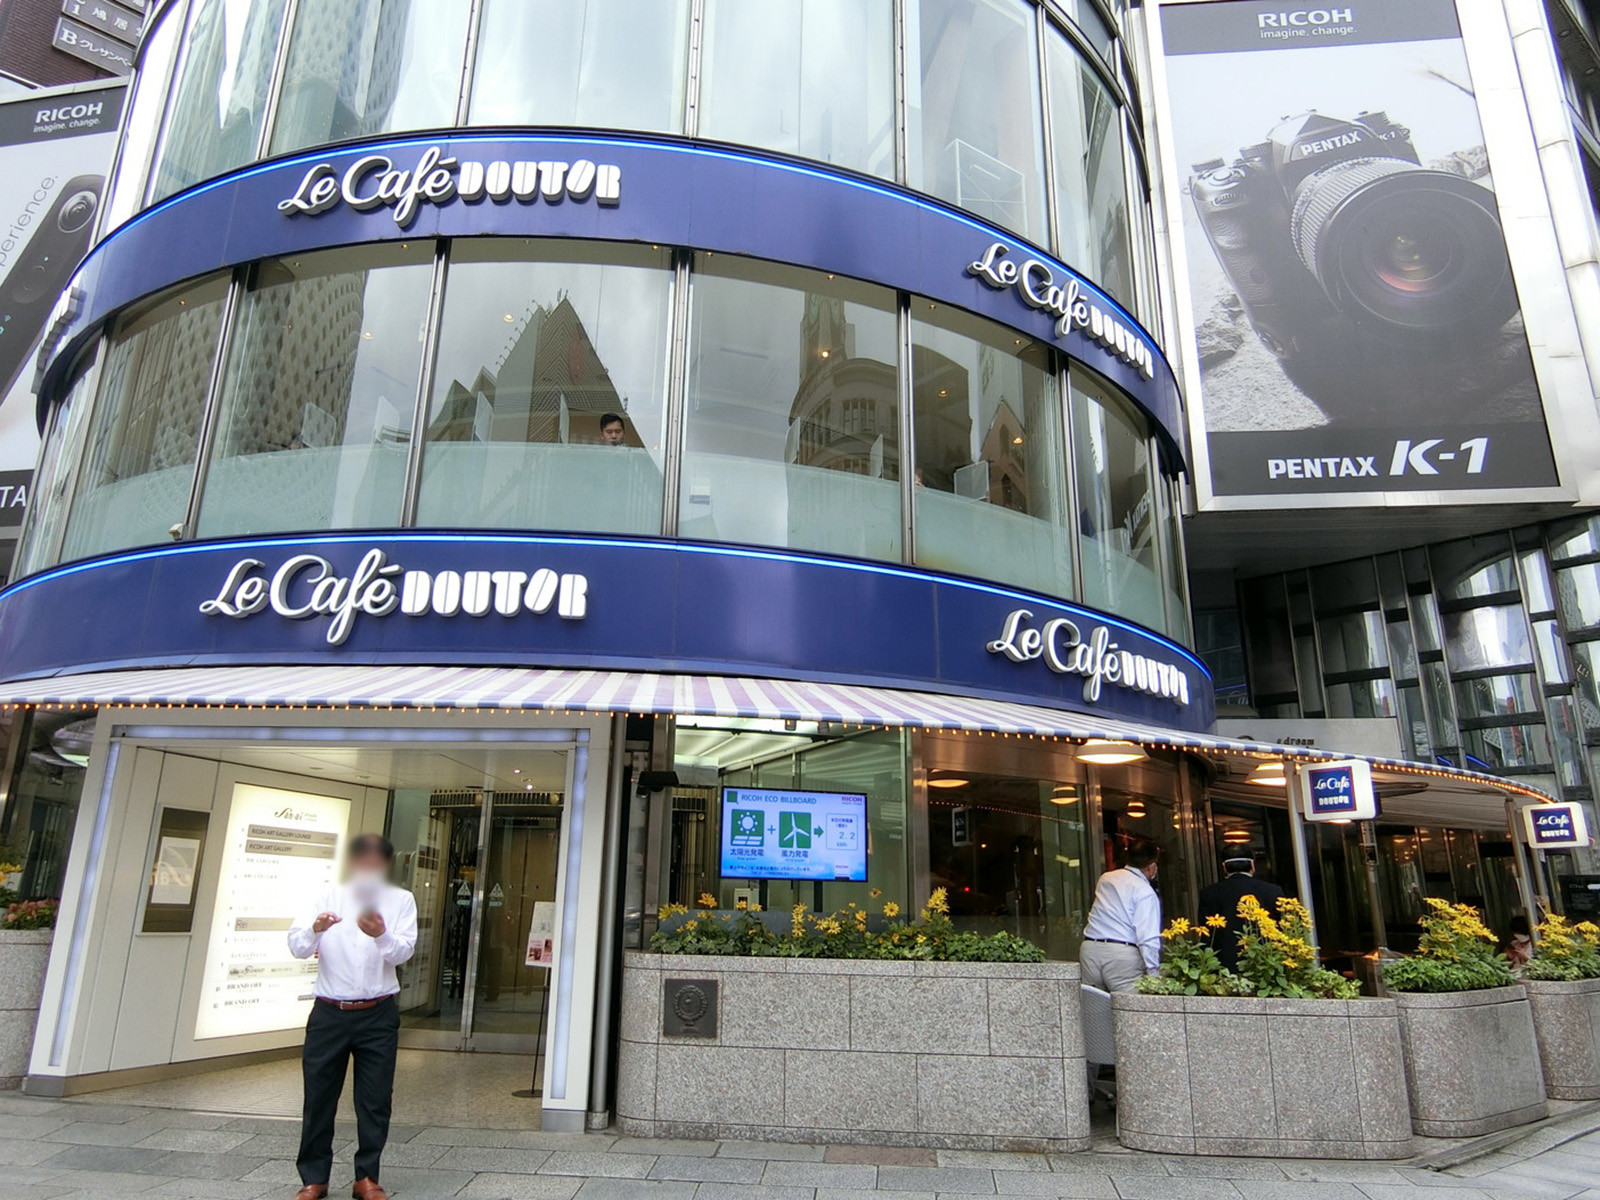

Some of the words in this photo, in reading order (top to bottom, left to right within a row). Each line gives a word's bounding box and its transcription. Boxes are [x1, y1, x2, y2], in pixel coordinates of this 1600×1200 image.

[1258, 8, 1352, 28] RICOH
[60, 27, 78, 45] B
[1260, 28, 1309, 39] imagine.
[1312, 26, 1357, 36] change.
[35, 102, 103, 123] RICOH
[33, 122, 67, 133] imagine.
[69, 118, 101, 128] change.
[1380, 131, 1396, 140] K-1
[1300, 131, 1361, 156] PENTAX
[278, 164, 340, 213] Le
[342, 146, 457, 227] Café
[457, 159, 621, 206] DOUTOR
[968, 243, 1018, 287] Le
[1018, 260, 1090, 338] Café
[1089, 305, 1154, 379] DOUTOR
[1267, 456, 1378, 479] PENTAX
[1389, 437, 1488, 476] K-1
[199, 558, 268, 618] Le
[270, 548, 402, 646] Café
[401, 568, 589, 620] DOUTOR
[986, 609, 1043, 662] Le
[1042, 618, 1121, 702] Café
[1120, 650, 1189, 705] DOUTOR
[1314, 779, 1327, 790] Le
[741, 794, 763, 802] RICOH
[765, 795, 779, 803] ECO
[780, 796, 817, 804] BILLBOARD
